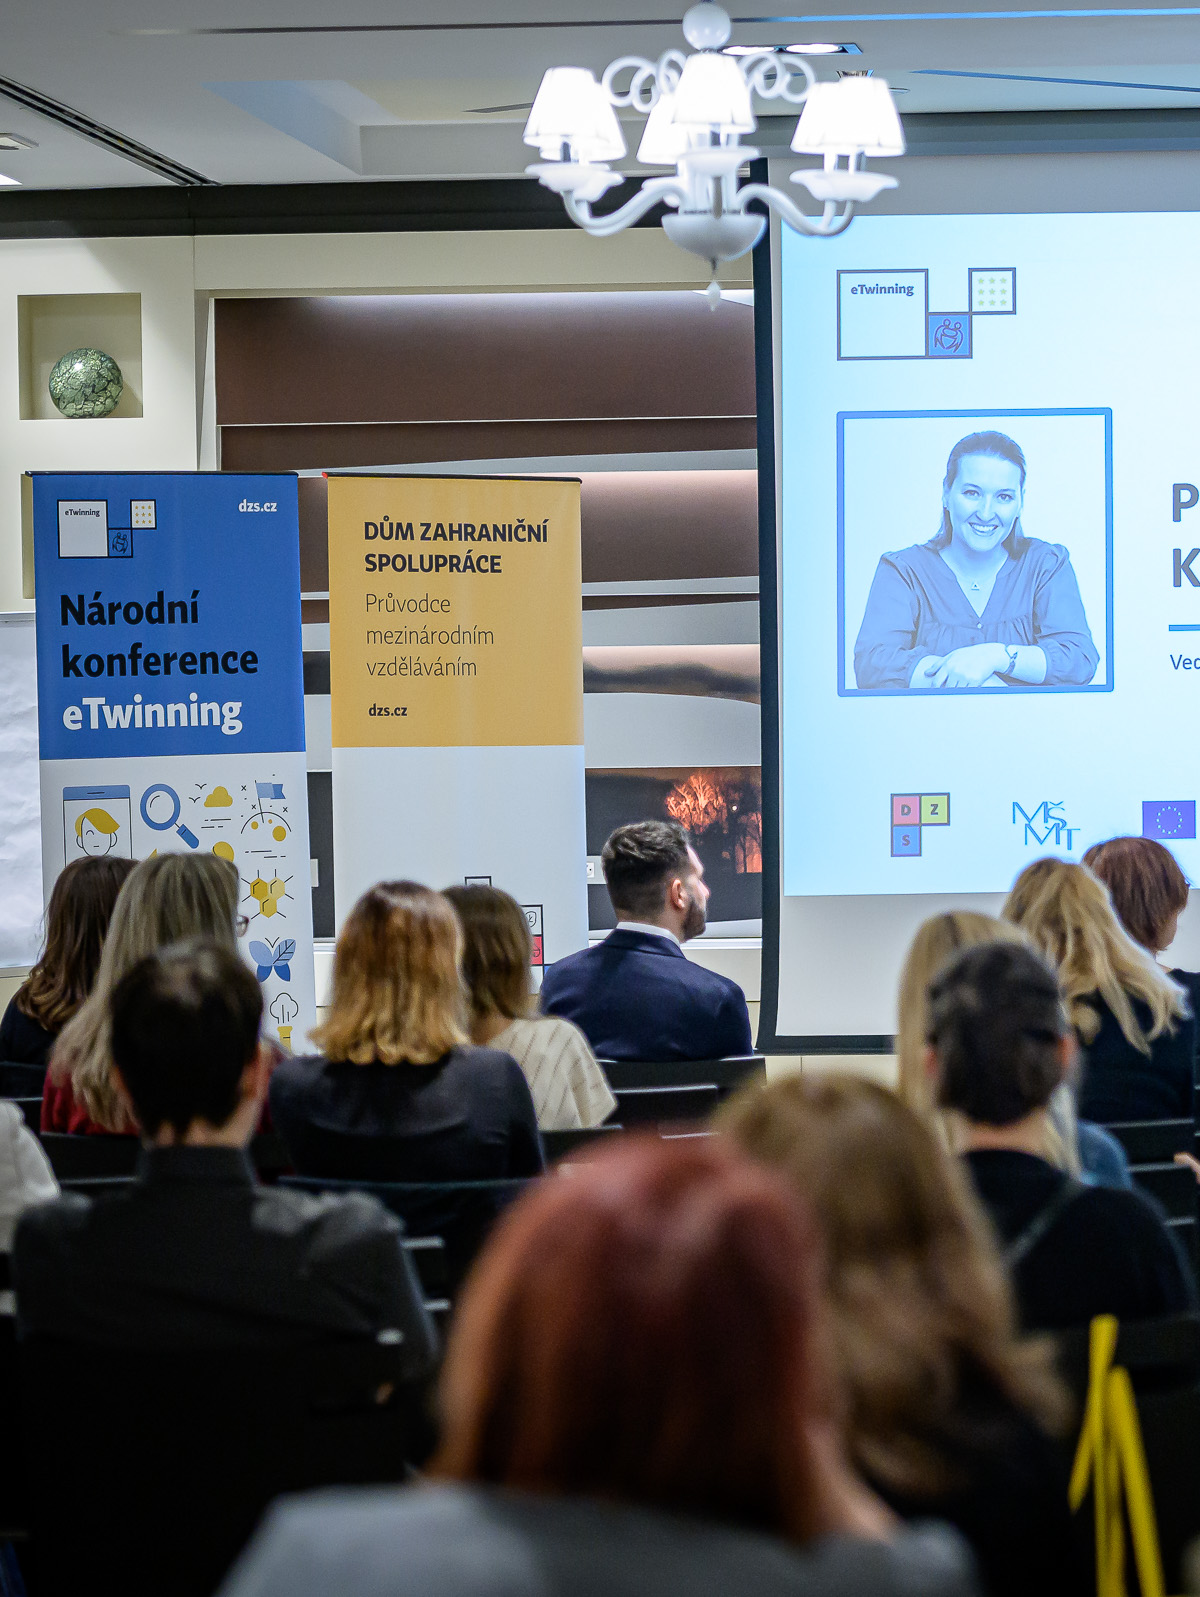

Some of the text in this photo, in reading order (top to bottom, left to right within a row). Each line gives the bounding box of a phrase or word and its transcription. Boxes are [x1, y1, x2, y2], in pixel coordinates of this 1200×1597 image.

[850, 282, 915, 297] eTwinning
[64, 508, 101, 518] eTwinning
[238, 499, 278, 513] dzs.cz
[364, 514, 550, 543] DŮM ZAHRANIČNÍ
[364, 550, 503, 574] SPOLUPRÁCE
[59, 589, 201, 627] Národní
[365, 592, 451, 614] Průvodce
[366, 624, 495, 645] mezinárodním
[61, 641, 259, 678] konference
[366, 655, 478, 678] vzděláváním
[62, 692, 243, 736] eTwinning
[368, 702, 408, 718] dzs.cz
[900, 803, 938, 816] D Z
[901, 834, 910, 847] S
